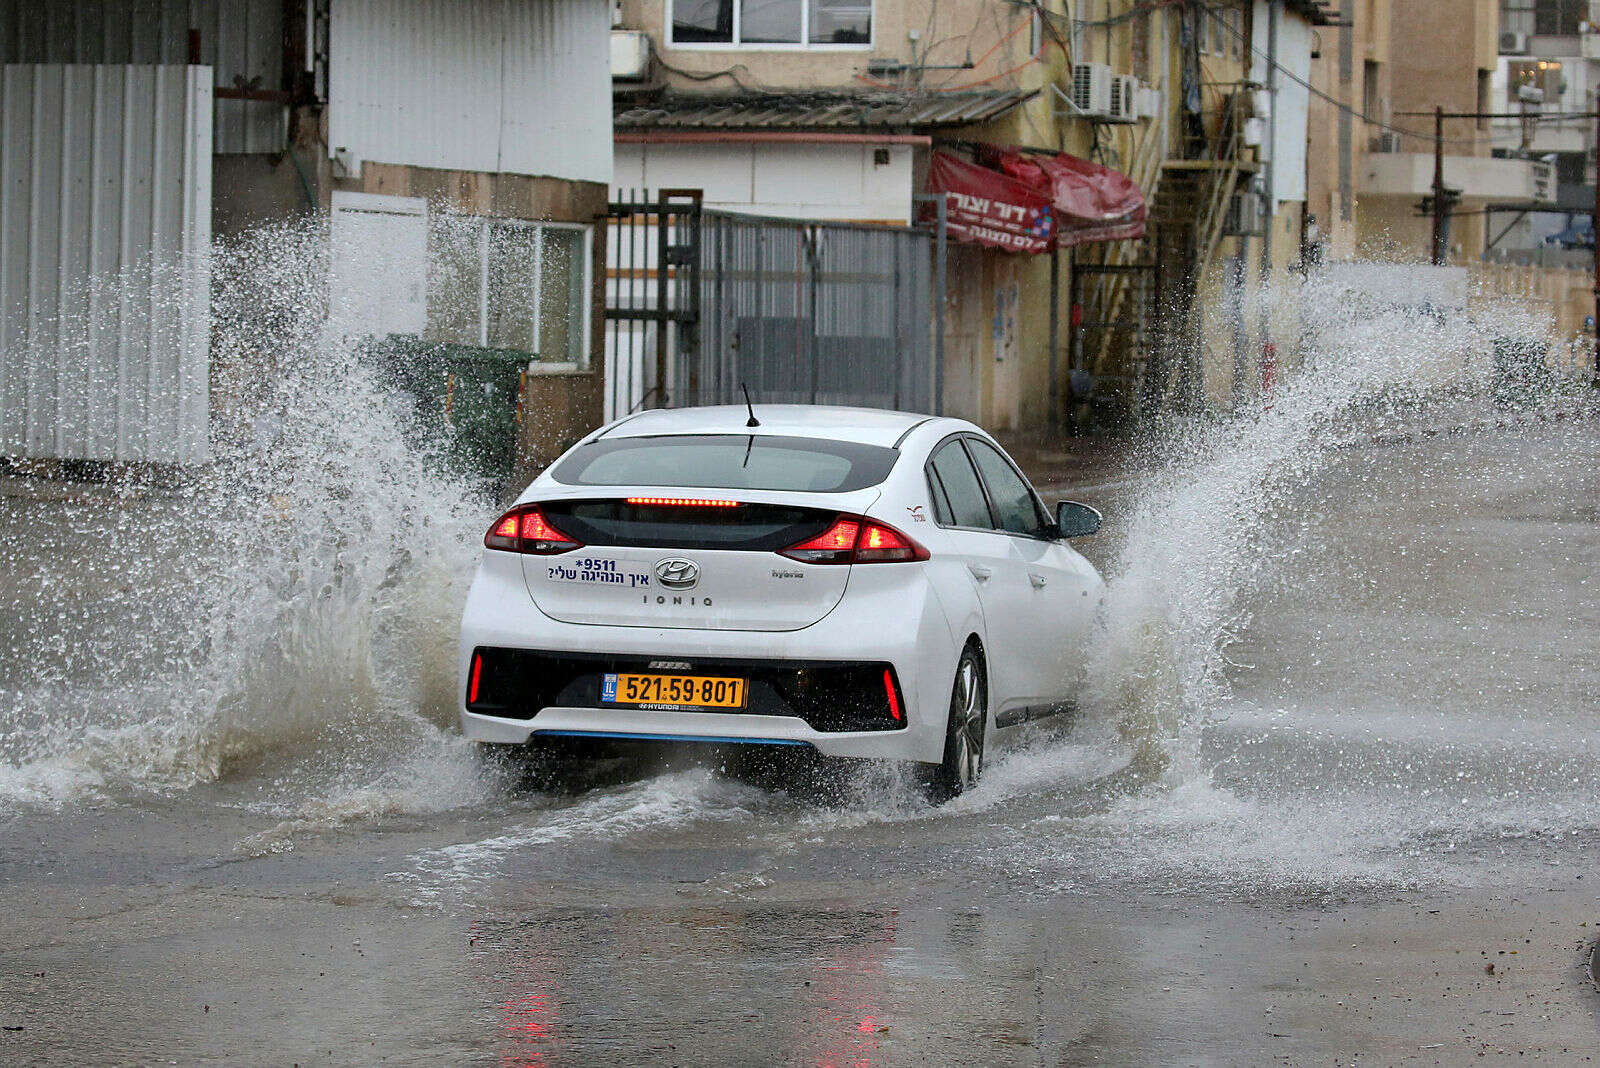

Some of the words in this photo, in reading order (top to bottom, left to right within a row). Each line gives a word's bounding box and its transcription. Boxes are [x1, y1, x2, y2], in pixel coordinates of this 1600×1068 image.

[548, 565, 577, 580] שלי?
[581, 570, 624, 583] הנהיגה
[628, 574, 649, 587] איך
[643, 595, 713, 607] IONIQ
[605, 682, 615, 693] IL
[648, 703, 680, 711] HYUNDAI
